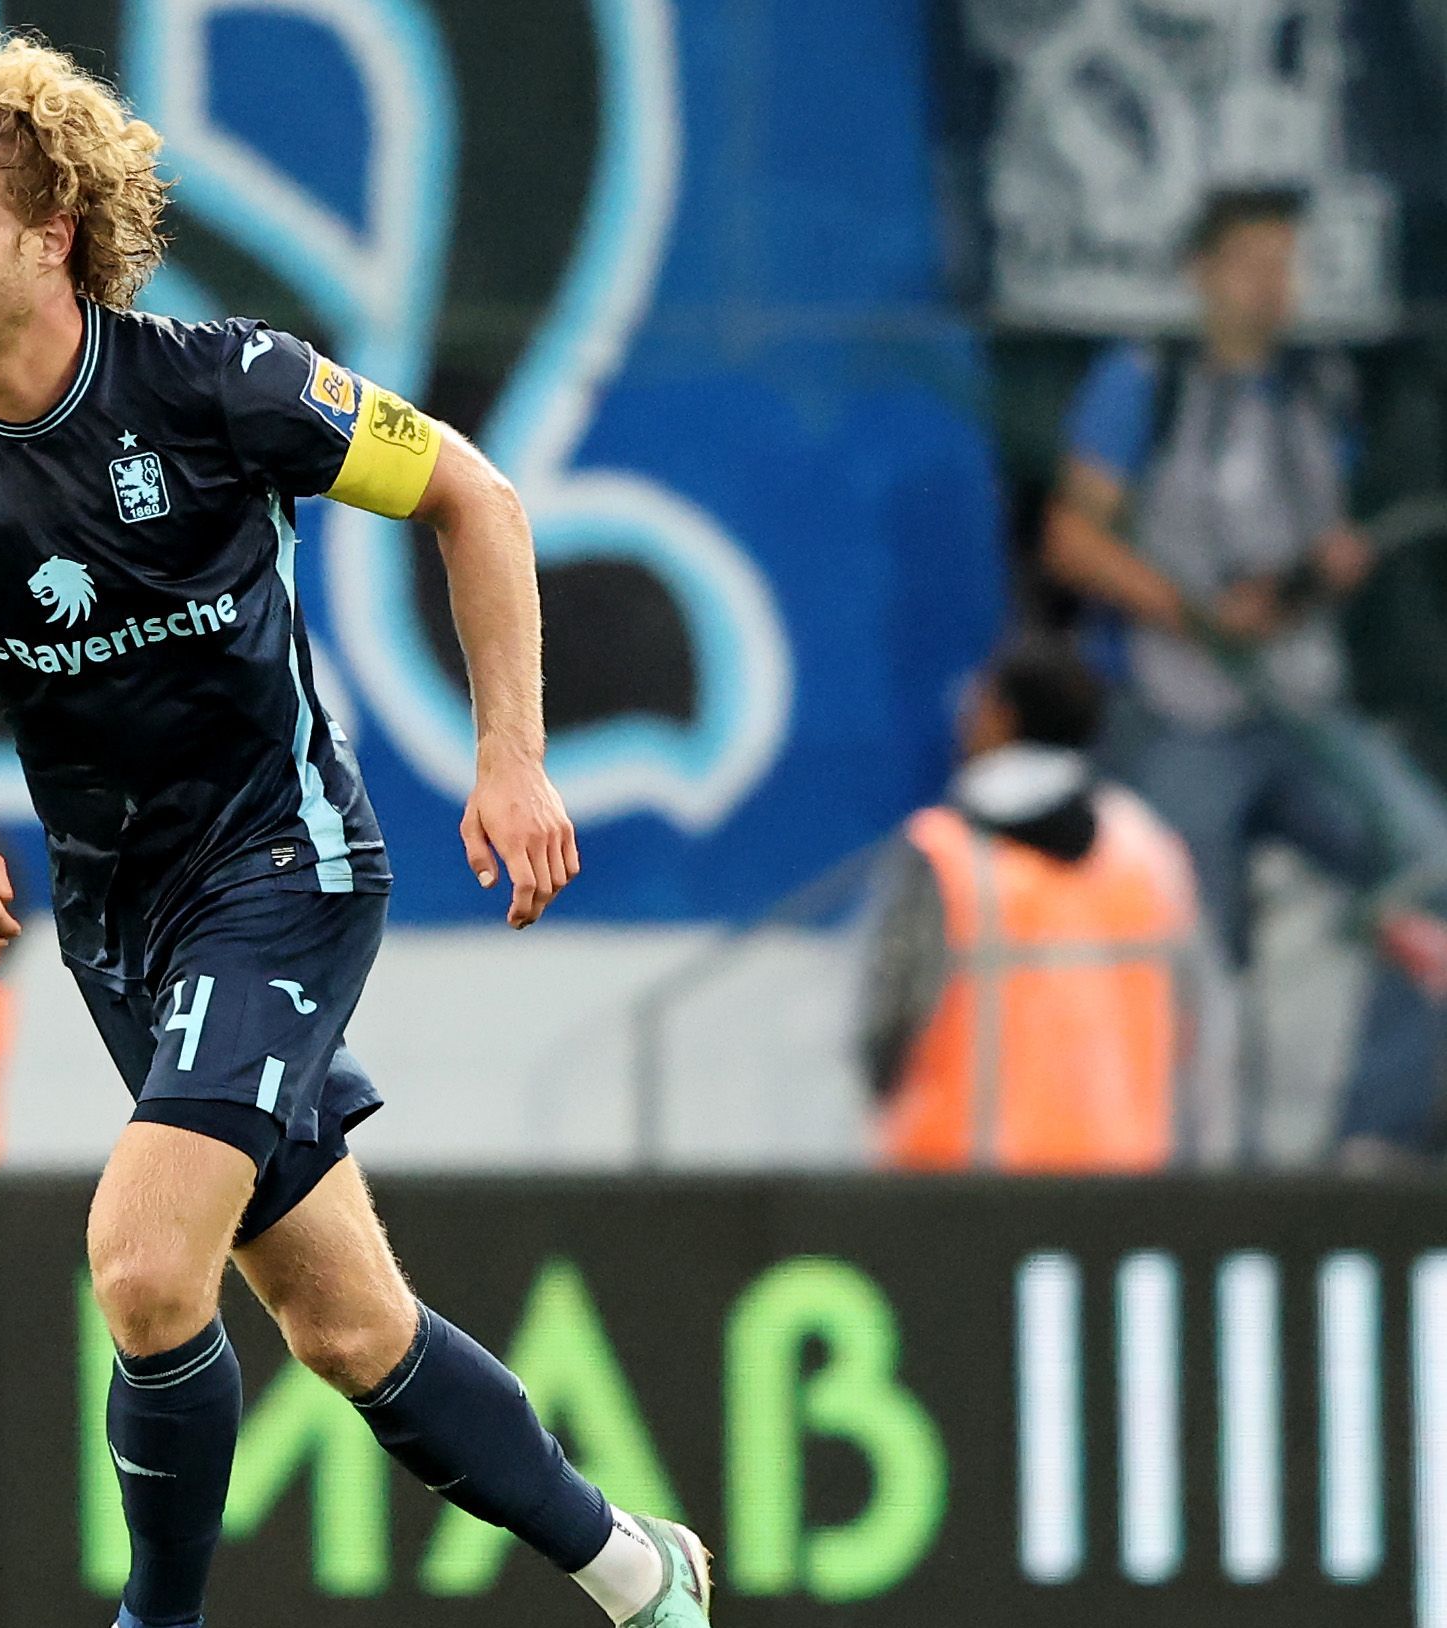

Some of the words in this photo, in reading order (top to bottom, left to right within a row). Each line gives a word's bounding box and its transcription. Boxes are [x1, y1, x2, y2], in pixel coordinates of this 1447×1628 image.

[130, 503, 160, 518] 1860
[4, 593, 237, 675] Bayerische
[164, 975, 215, 1071] 4
